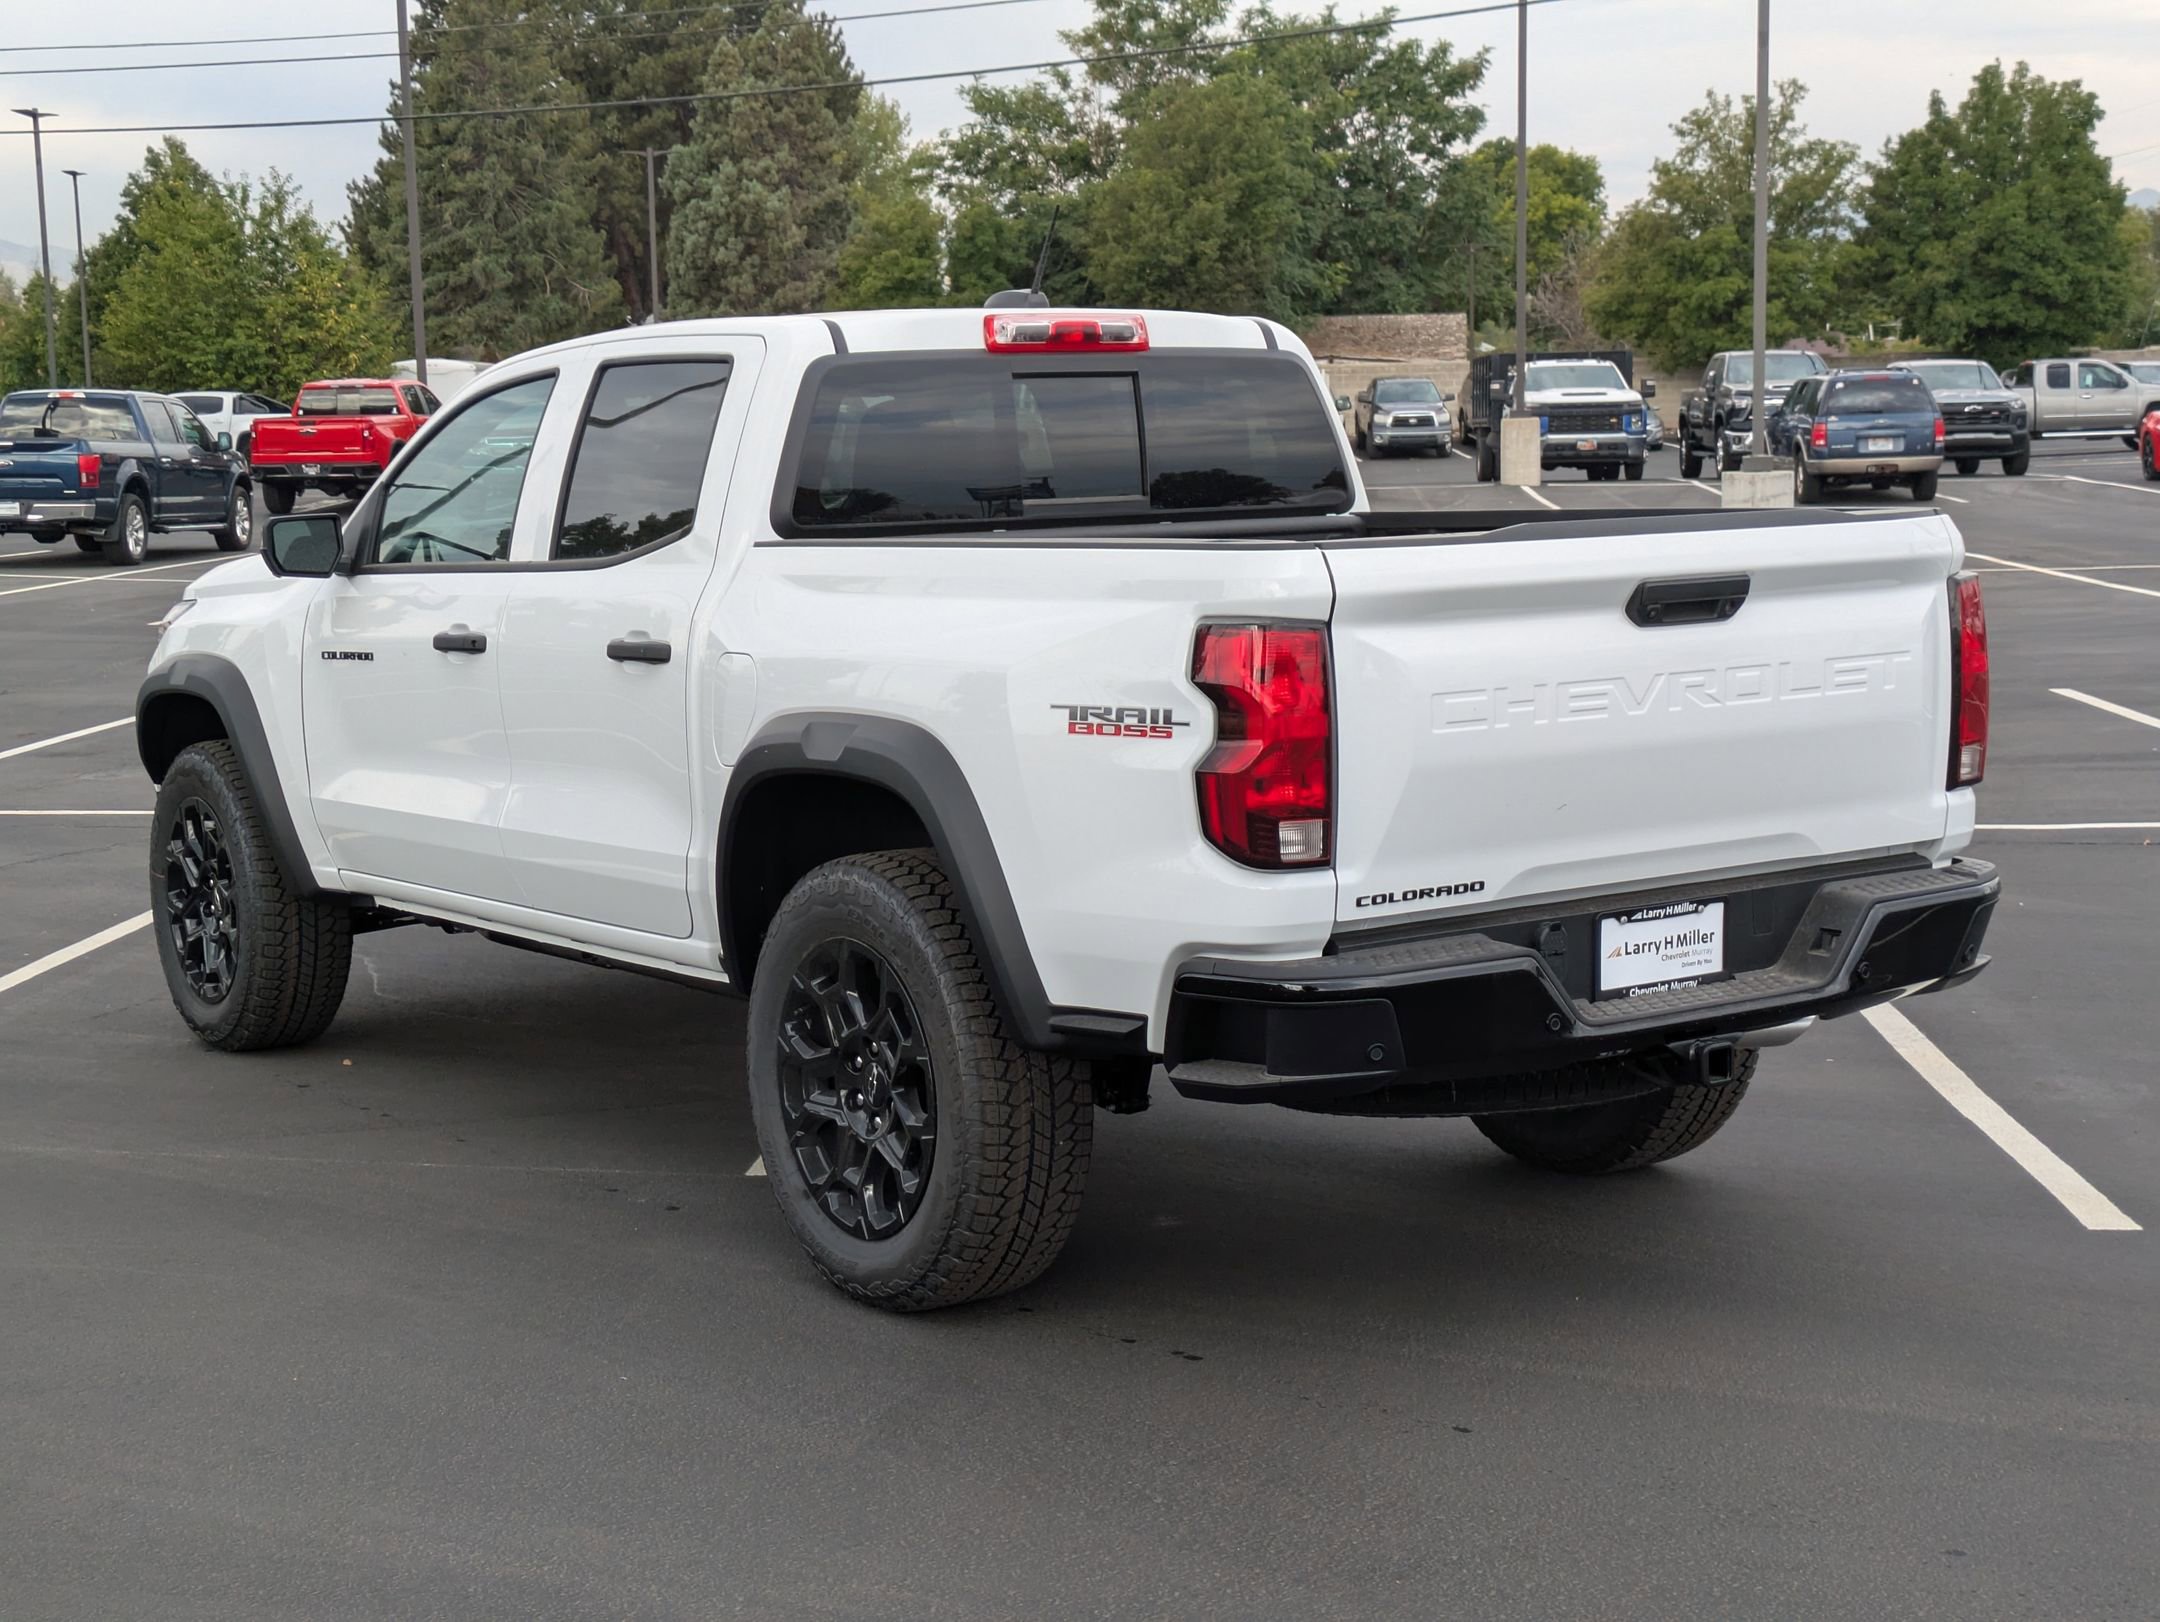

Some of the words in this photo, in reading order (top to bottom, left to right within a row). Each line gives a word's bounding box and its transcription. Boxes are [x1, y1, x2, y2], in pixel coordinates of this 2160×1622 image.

[1431, 649, 1912, 733] CHEVROLET
[1050, 704, 1190, 727] TRAIL
[1068, 722, 1173, 739] BOSS
[1356, 881, 1485, 907] COLORADO
[1643, 908, 1667, 919] Larry
[1666, 906, 1674, 916] H
[1674, 902, 1697, 914] Miller
[1624, 940, 1662, 956] Larry
[1664, 936, 1674, 950] H
[1676, 929, 1715, 948] Miller
[1661, 951, 1690, 962] Chevrolet
[1691, 948, 1713, 957] Murray
[1629, 984, 1669, 997] Chevrolet
[1670, 978, 1698, 991] Murray
